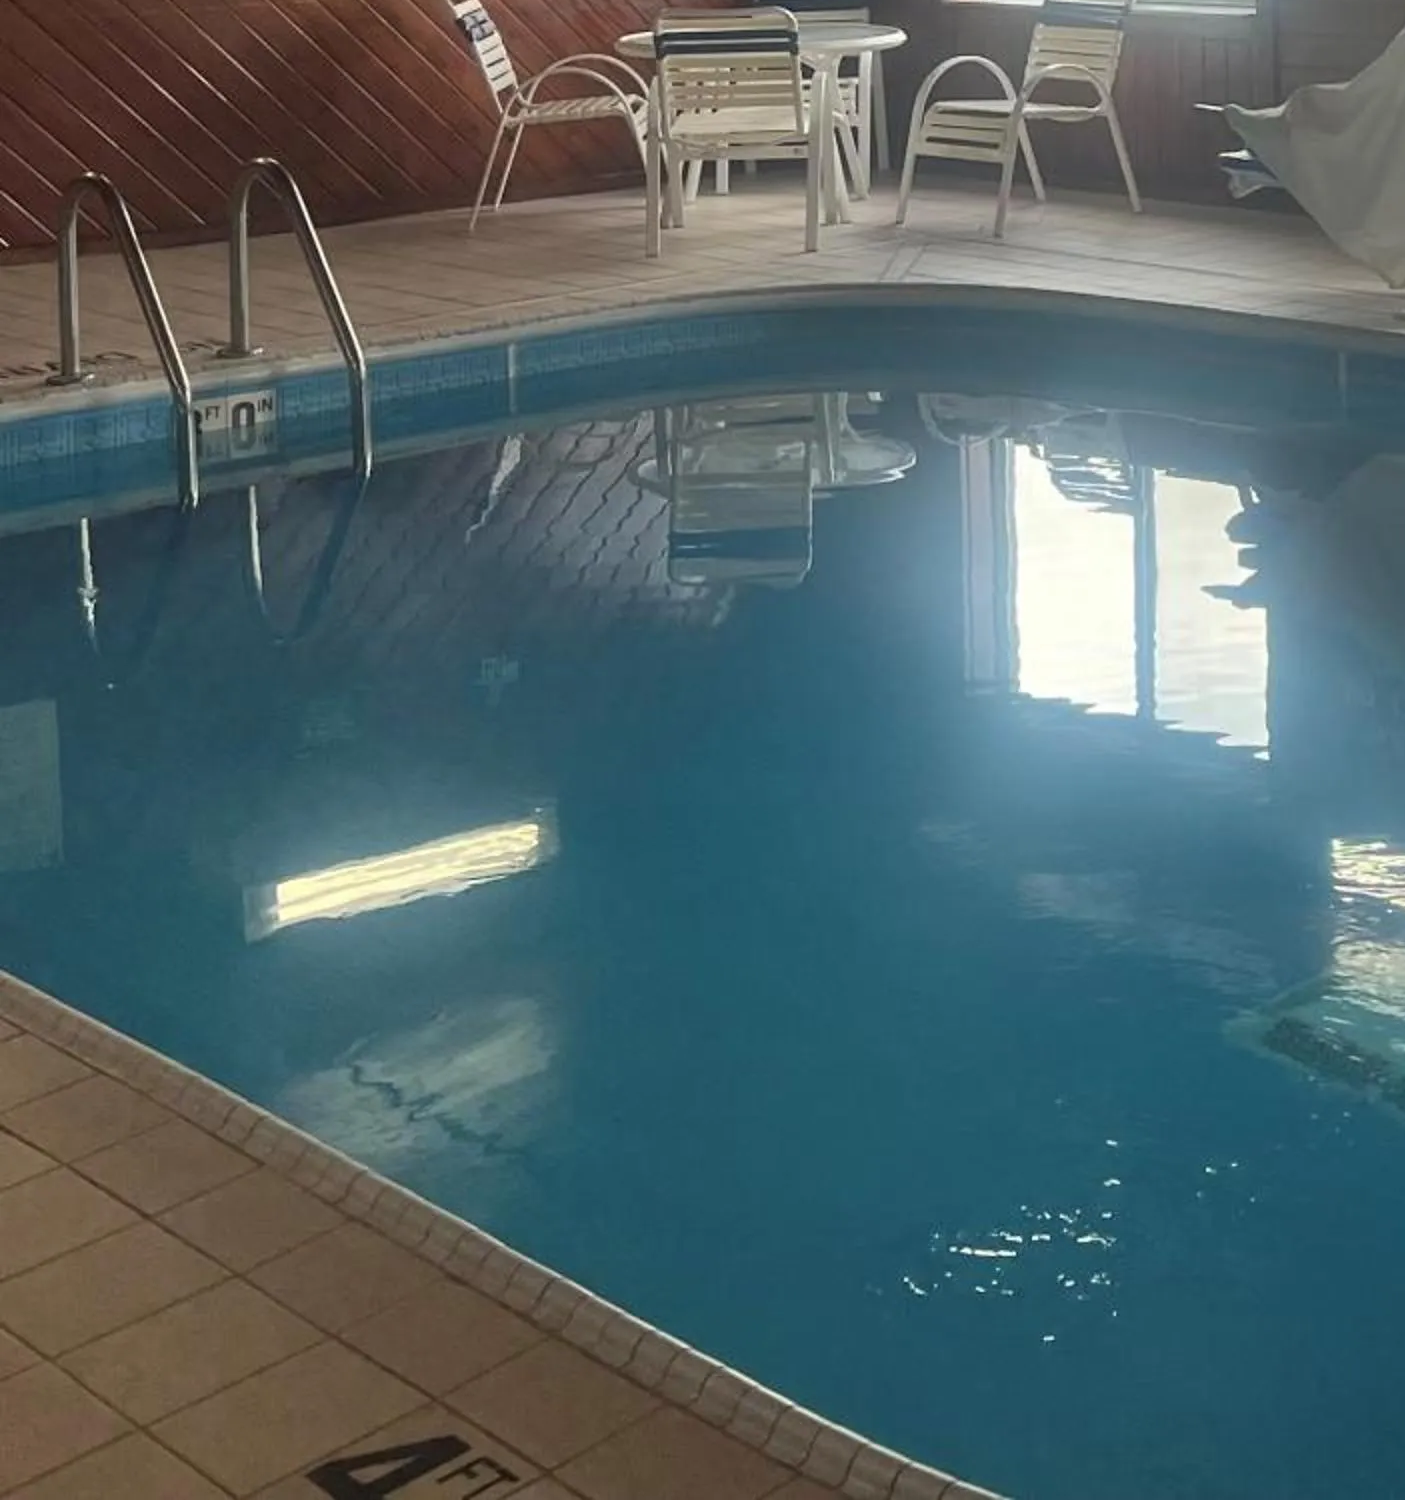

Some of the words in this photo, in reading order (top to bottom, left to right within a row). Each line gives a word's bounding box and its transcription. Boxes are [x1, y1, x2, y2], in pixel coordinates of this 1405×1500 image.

[257, 396, 273, 413] IN
[304, 1434, 472, 1500] 4
[436, 1456, 521, 1500] FT
